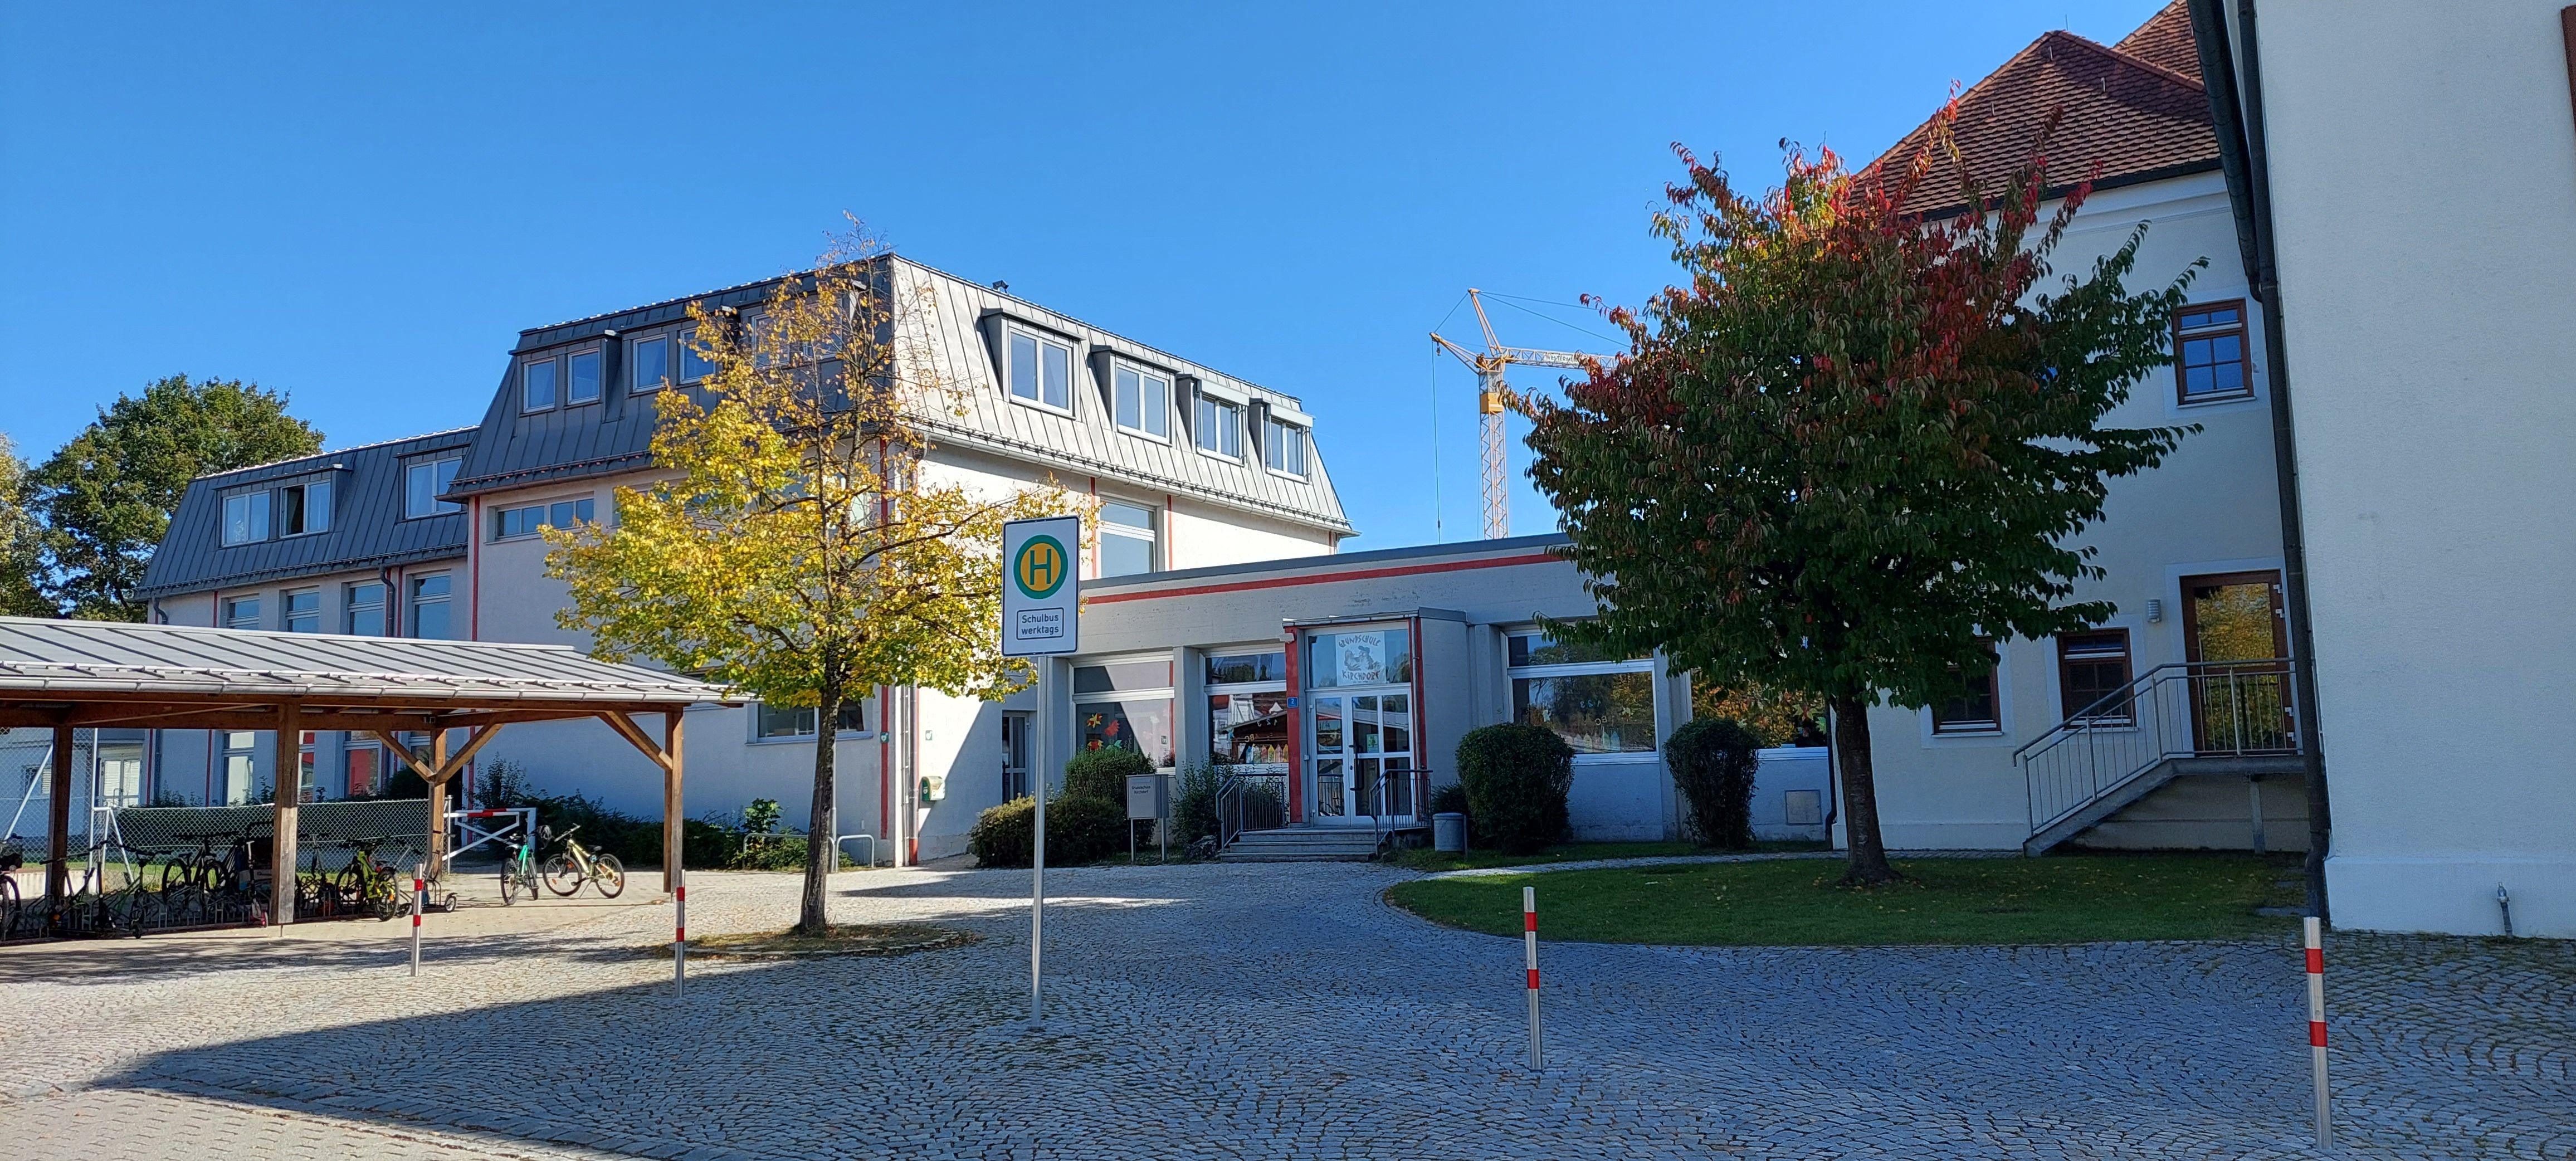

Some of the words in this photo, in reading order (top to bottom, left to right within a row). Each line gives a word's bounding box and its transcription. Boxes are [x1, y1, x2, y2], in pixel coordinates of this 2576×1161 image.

[1029, 548, 1052, 586] H
[1022, 613, 1059, 623] Schulbus
[1021, 625, 1059, 635] werktags
[1338, 635, 1381, 647] GRUNDSCHULE
